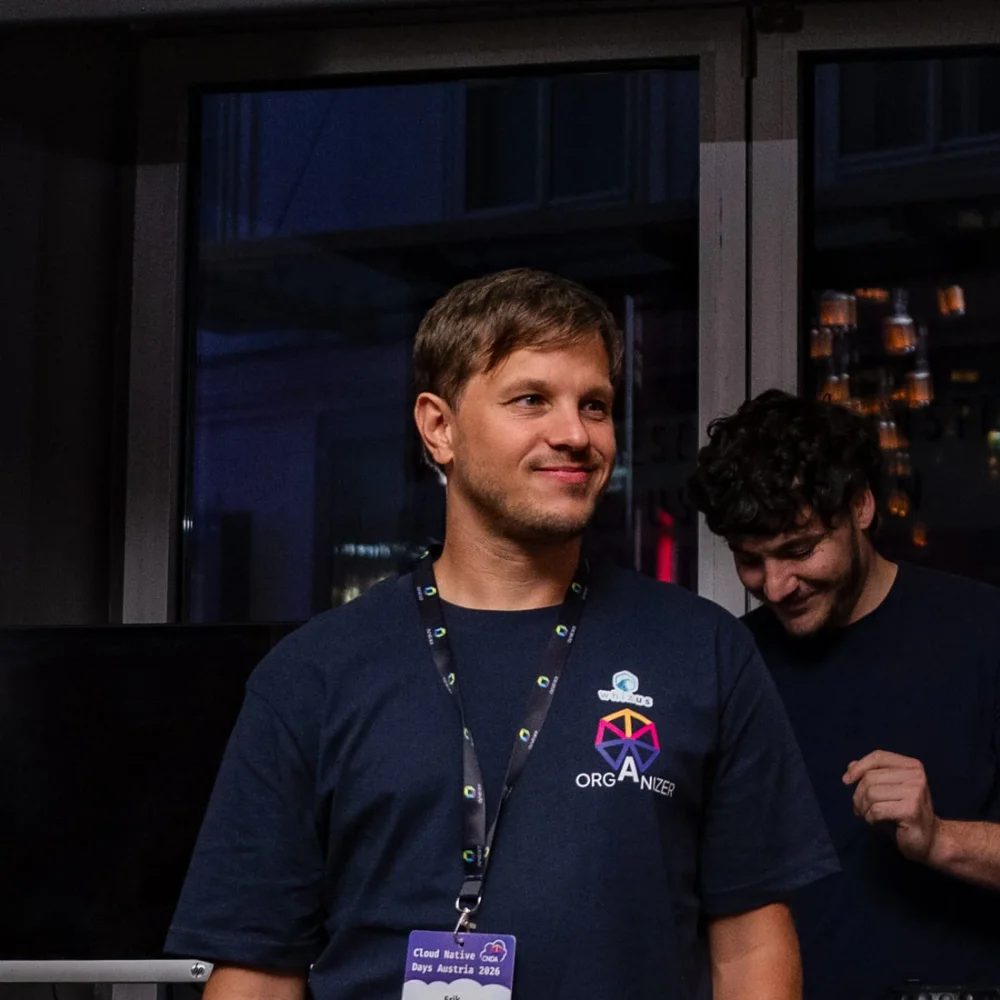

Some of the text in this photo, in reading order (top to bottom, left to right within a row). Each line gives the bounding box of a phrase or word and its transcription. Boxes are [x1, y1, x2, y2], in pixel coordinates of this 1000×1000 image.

[575, 756, 676, 797] ORGANIZER
[413, 947, 476, 960] Cloud Native
[411, 962, 501, 976] Days Austria 2026
